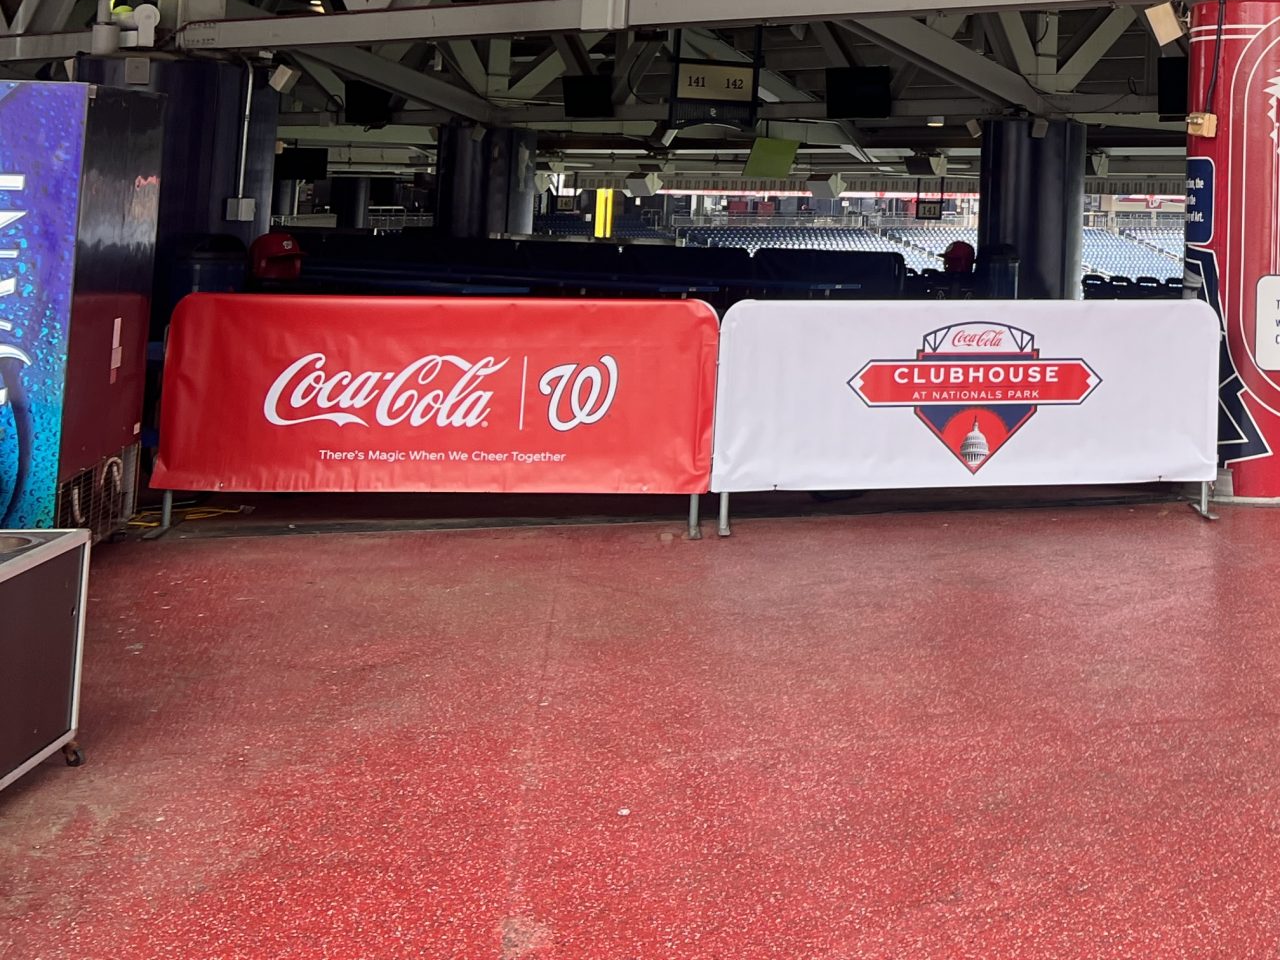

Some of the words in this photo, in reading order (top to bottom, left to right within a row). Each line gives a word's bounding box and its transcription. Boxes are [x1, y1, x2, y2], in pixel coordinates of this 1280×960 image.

[688, 75, 706, 87] 141
[725, 78, 744, 90] 142
[922, 205, 937, 216] 141
[893, 366, 1059, 384] CLUBHOUSE
[263, 352, 510, 428] Coca-Cola
[538, 354, 619, 432] W
[912, 391, 929, 400] AT
[932, 390, 1003, 400] NATIONALS
[1008, 389, 1040, 399] PARK
[319, 450, 365, 460] There's
[368, 450, 405, 462] Magic
[409, 450, 445, 461] When
[449, 451, 468, 461] We
[472, 451, 508, 461] Cheer
[512, 451, 567, 463] Together
